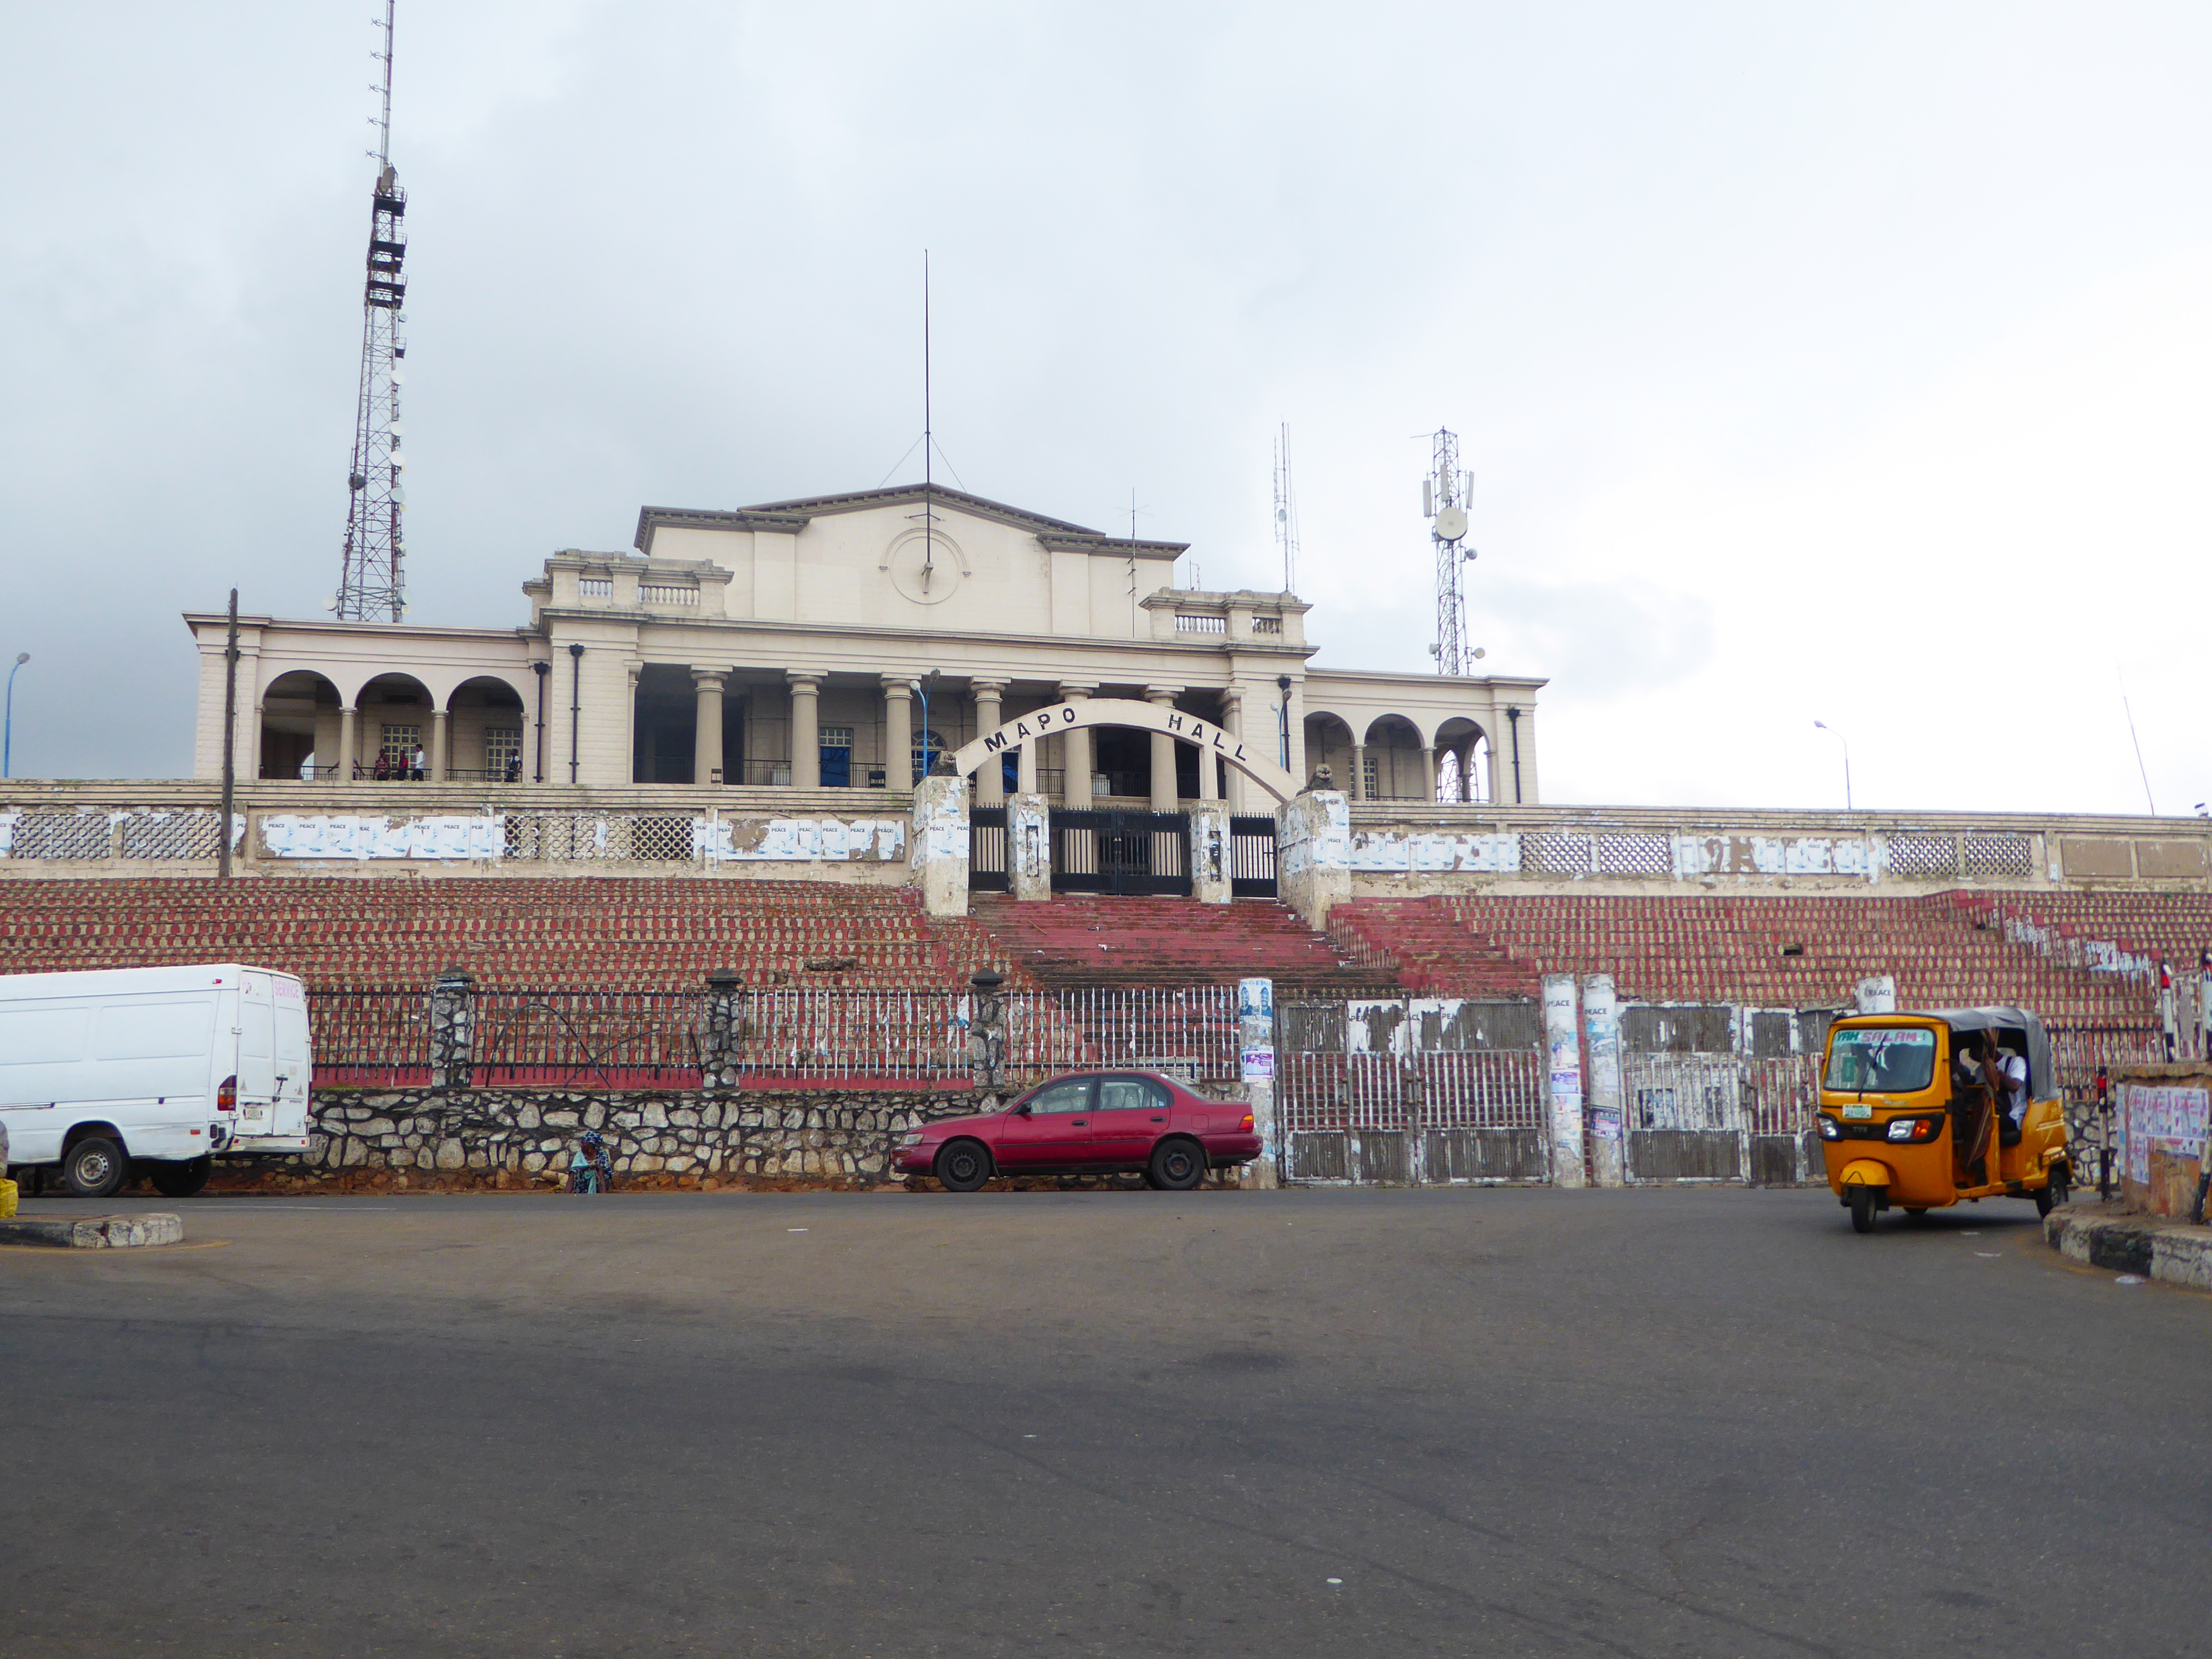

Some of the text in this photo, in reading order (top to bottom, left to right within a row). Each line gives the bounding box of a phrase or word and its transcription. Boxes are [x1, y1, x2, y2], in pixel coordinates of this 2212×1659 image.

[984, 707, 1246, 761] MAPO HALL
[275, 980, 300, 999] SERVICE
[1861, 1031, 1917, 1042] SALAM
